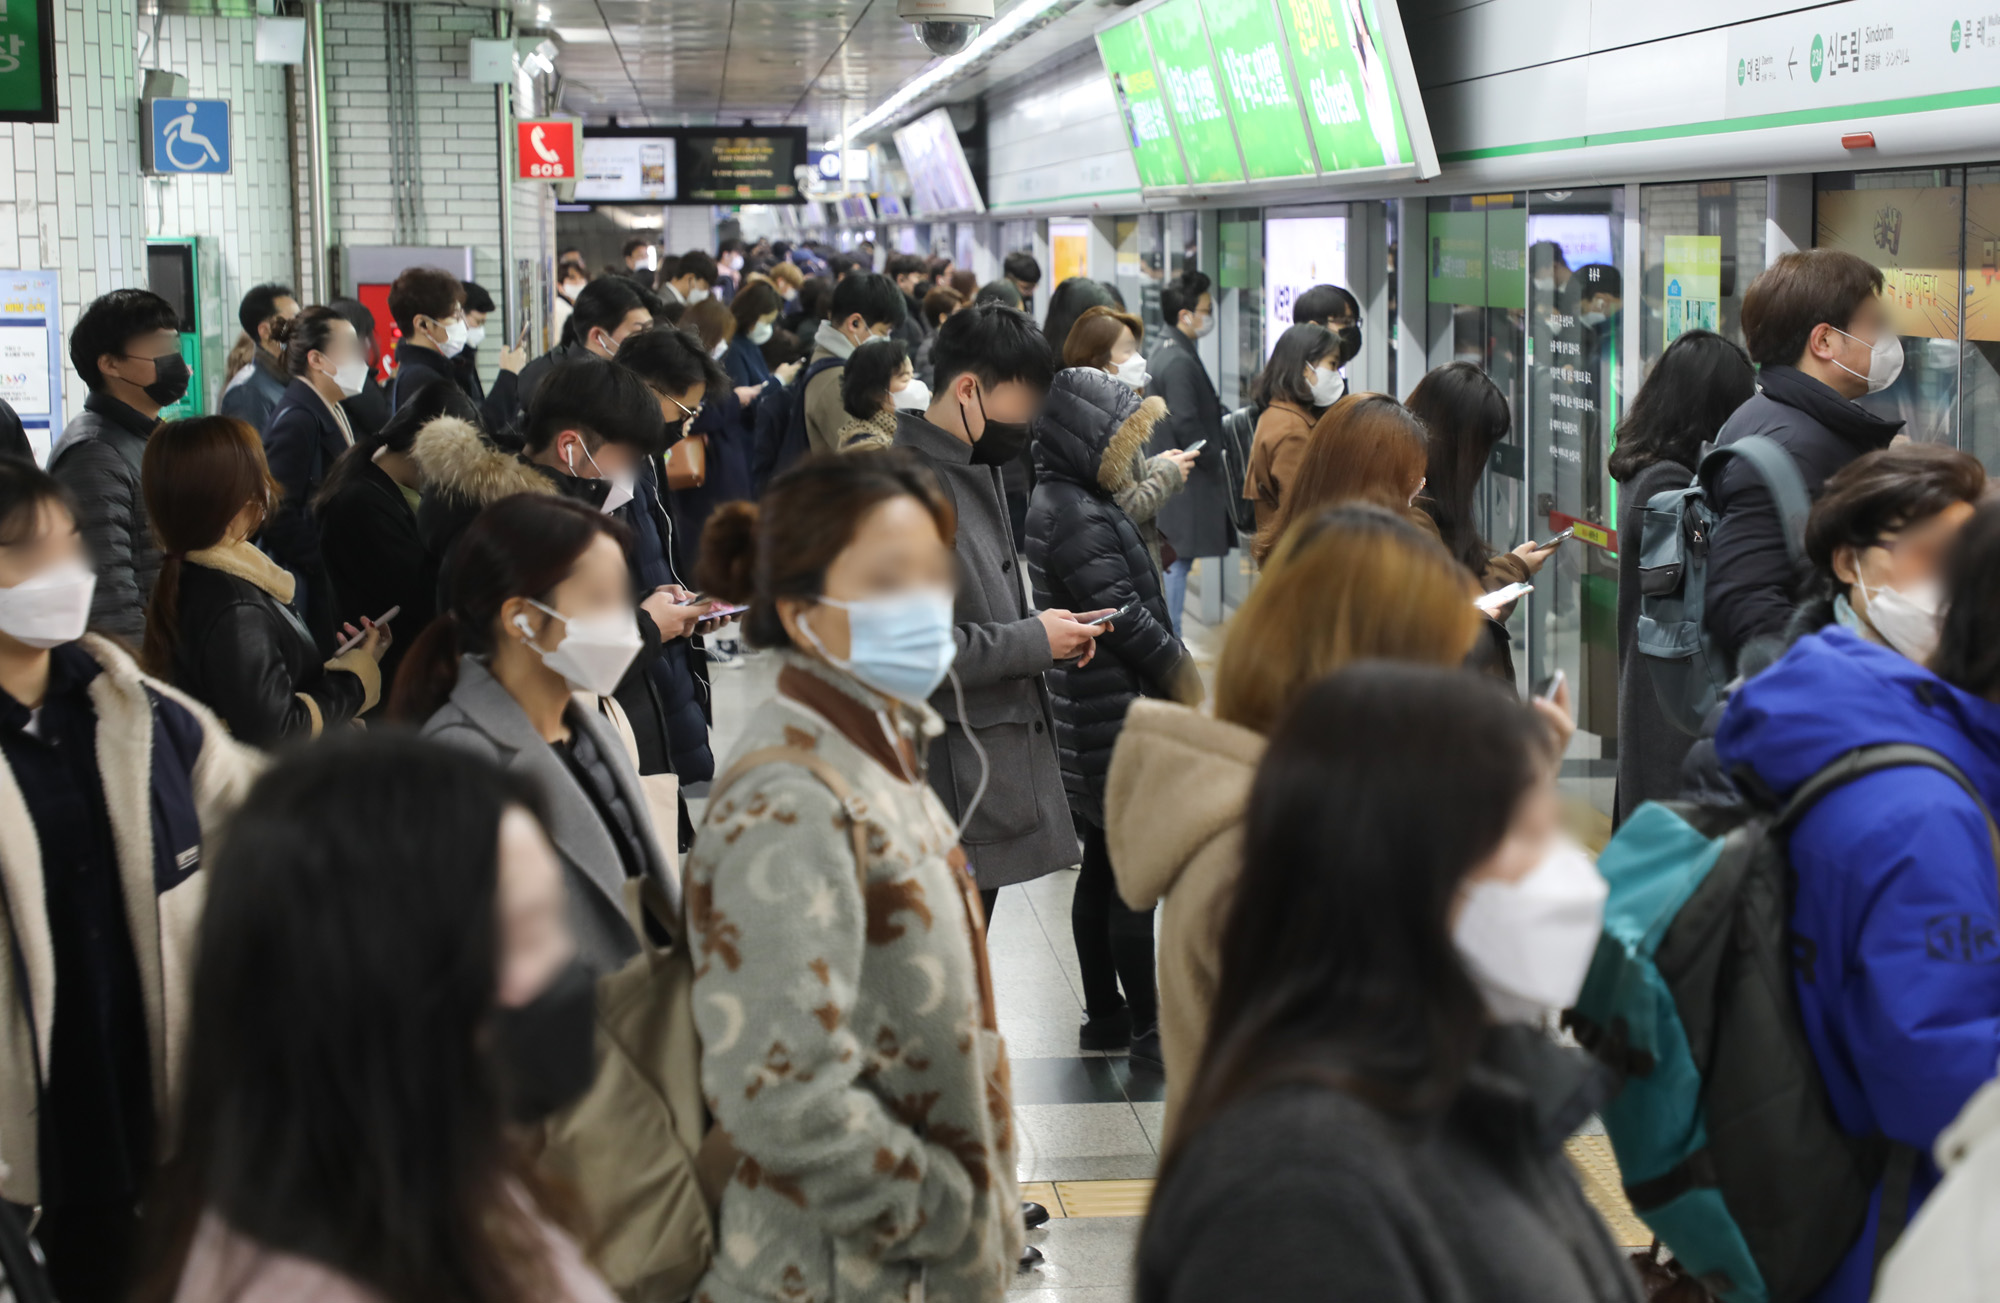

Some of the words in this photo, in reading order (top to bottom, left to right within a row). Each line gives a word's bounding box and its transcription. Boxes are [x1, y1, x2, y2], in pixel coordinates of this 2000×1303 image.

[1865, 23, 1894, 44] Sindorim
[1811, 49, 1823, 67] 234
[1827, 28, 1861, 76] 신도림
[530, 163, 564, 177] SOS
